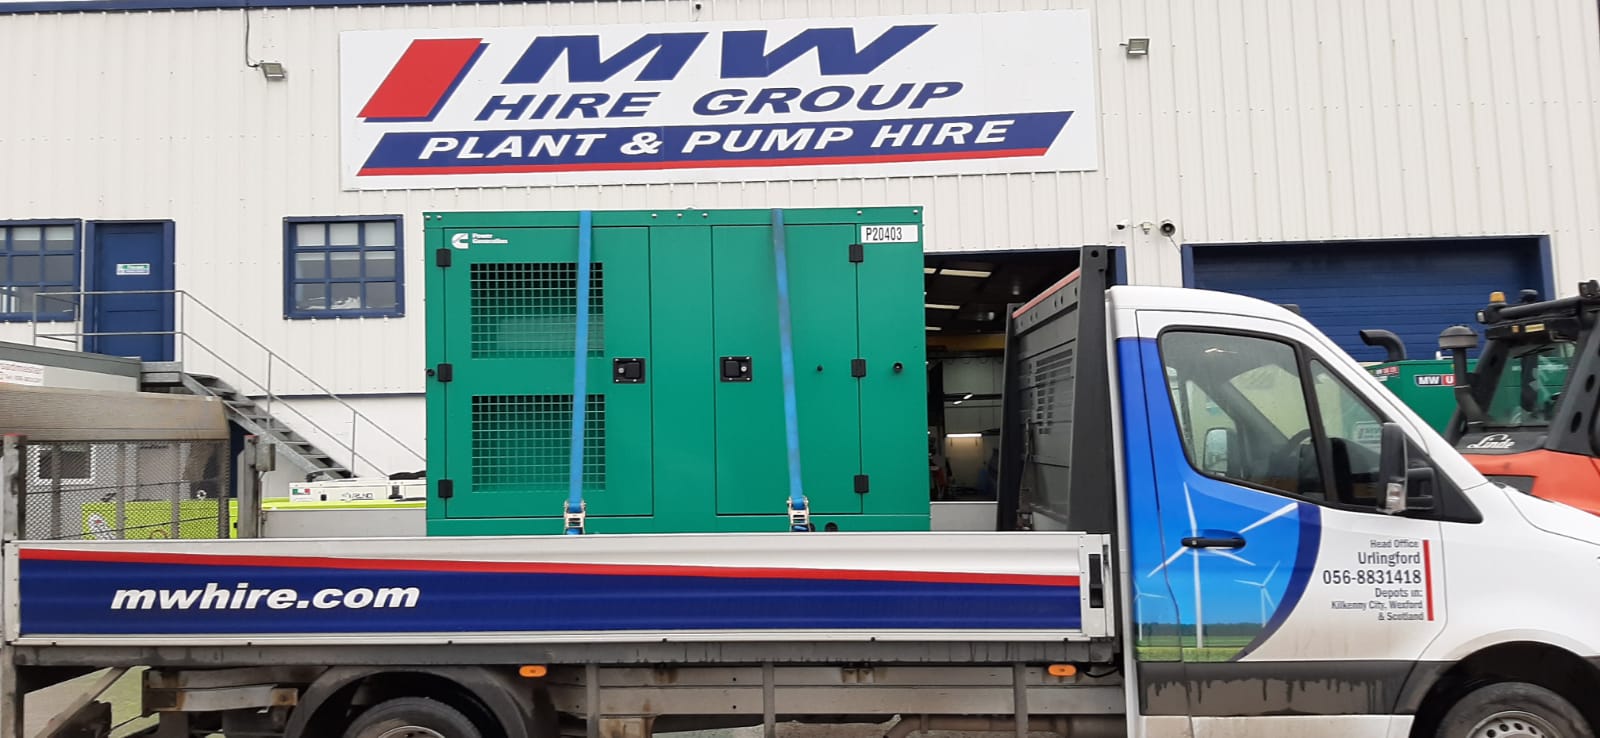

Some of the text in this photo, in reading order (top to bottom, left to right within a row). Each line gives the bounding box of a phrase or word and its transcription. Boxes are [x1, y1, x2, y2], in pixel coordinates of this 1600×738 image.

[500, 24, 938, 84] MW
[474, 80, 965, 122] HIRE GROUP
[418, 118, 1016, 161] PLANT & PUMP HIRE
[865, 227, 903, 241] P20403
[1418, 375, 1440, 385] MW
[1467, 433, 1516, 449] Linde
[1370, 539, 1419, 548] Head Office
[1358, 552, 1421, 567] Urlingford
[1323, 570, 1422, 584] 056-8831418
[110, 582, 420, 610] mwhire.com
[1375, 588, 1409, 599] Depots
[1378, 612, 1424, 621] & Scotland
